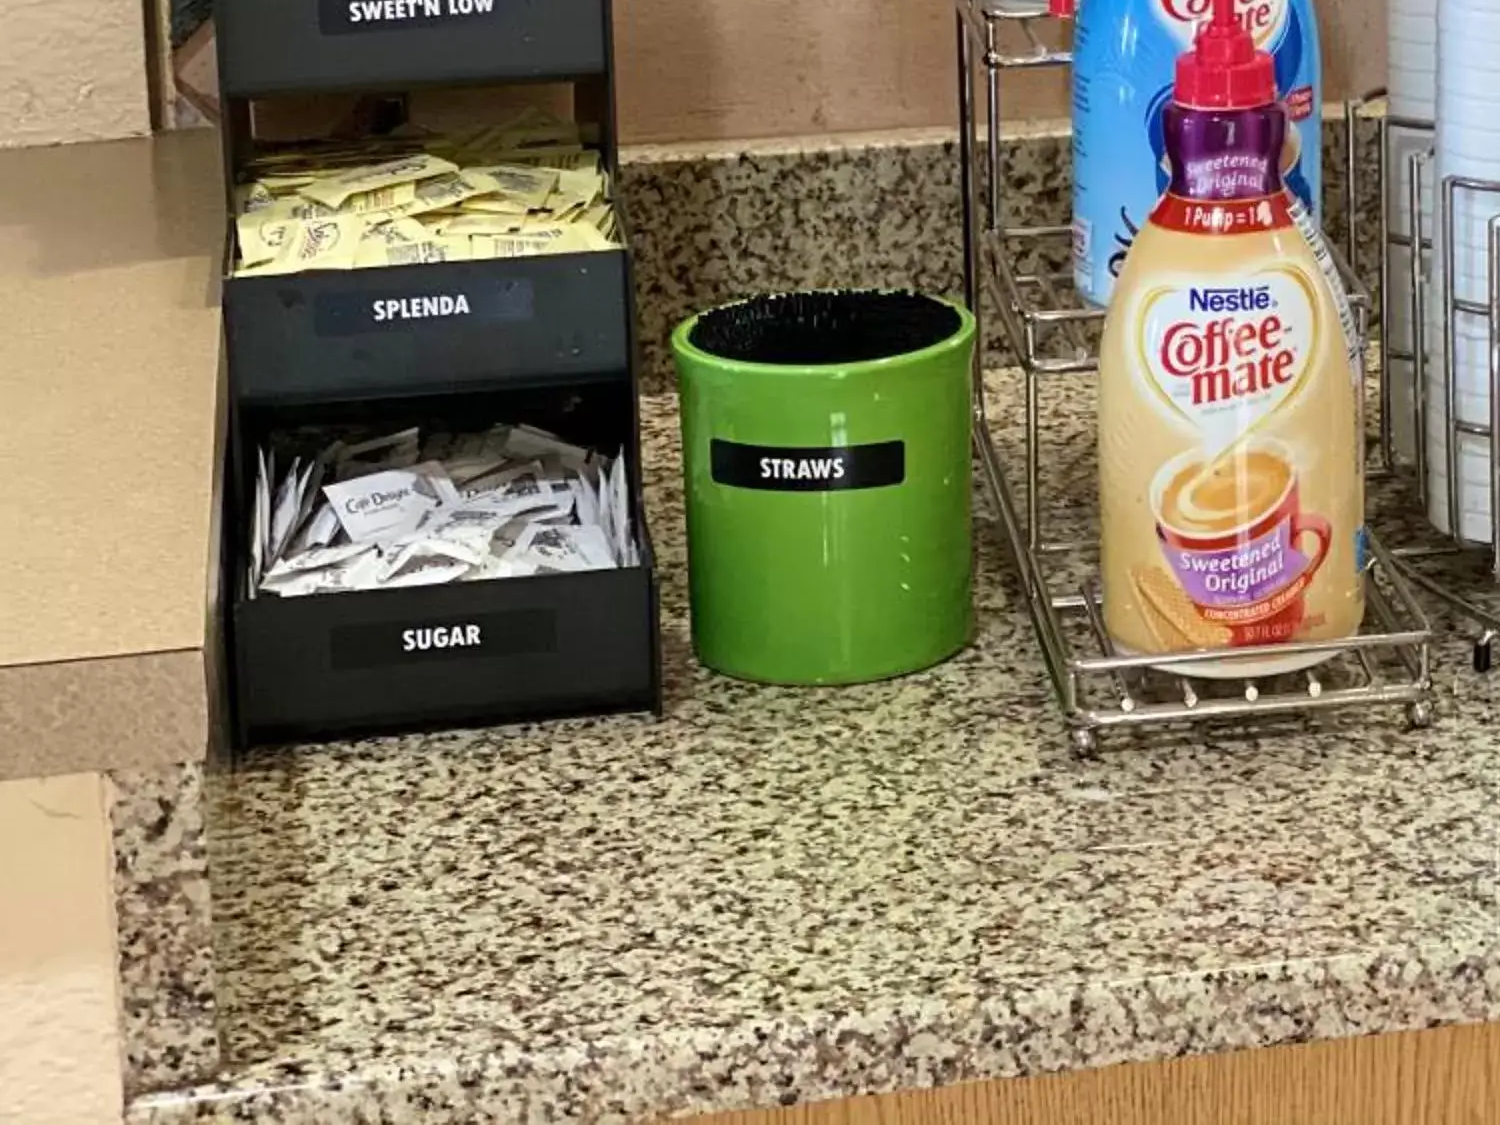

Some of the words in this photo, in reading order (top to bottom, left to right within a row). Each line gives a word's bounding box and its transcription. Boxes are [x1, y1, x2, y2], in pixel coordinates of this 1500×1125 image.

[373, 294, 470, 322] SPLENDA
[1189, 285, 1270, 312] Nestlé
[1192, 350, 1295, 405] mate
[760, 457, 845, 480] STRAWS
[1180, 528, 1281, 572] Sweetened
[1205, 551, 1284, 593] Original
[402, 624, 481, 652] SUGAR
